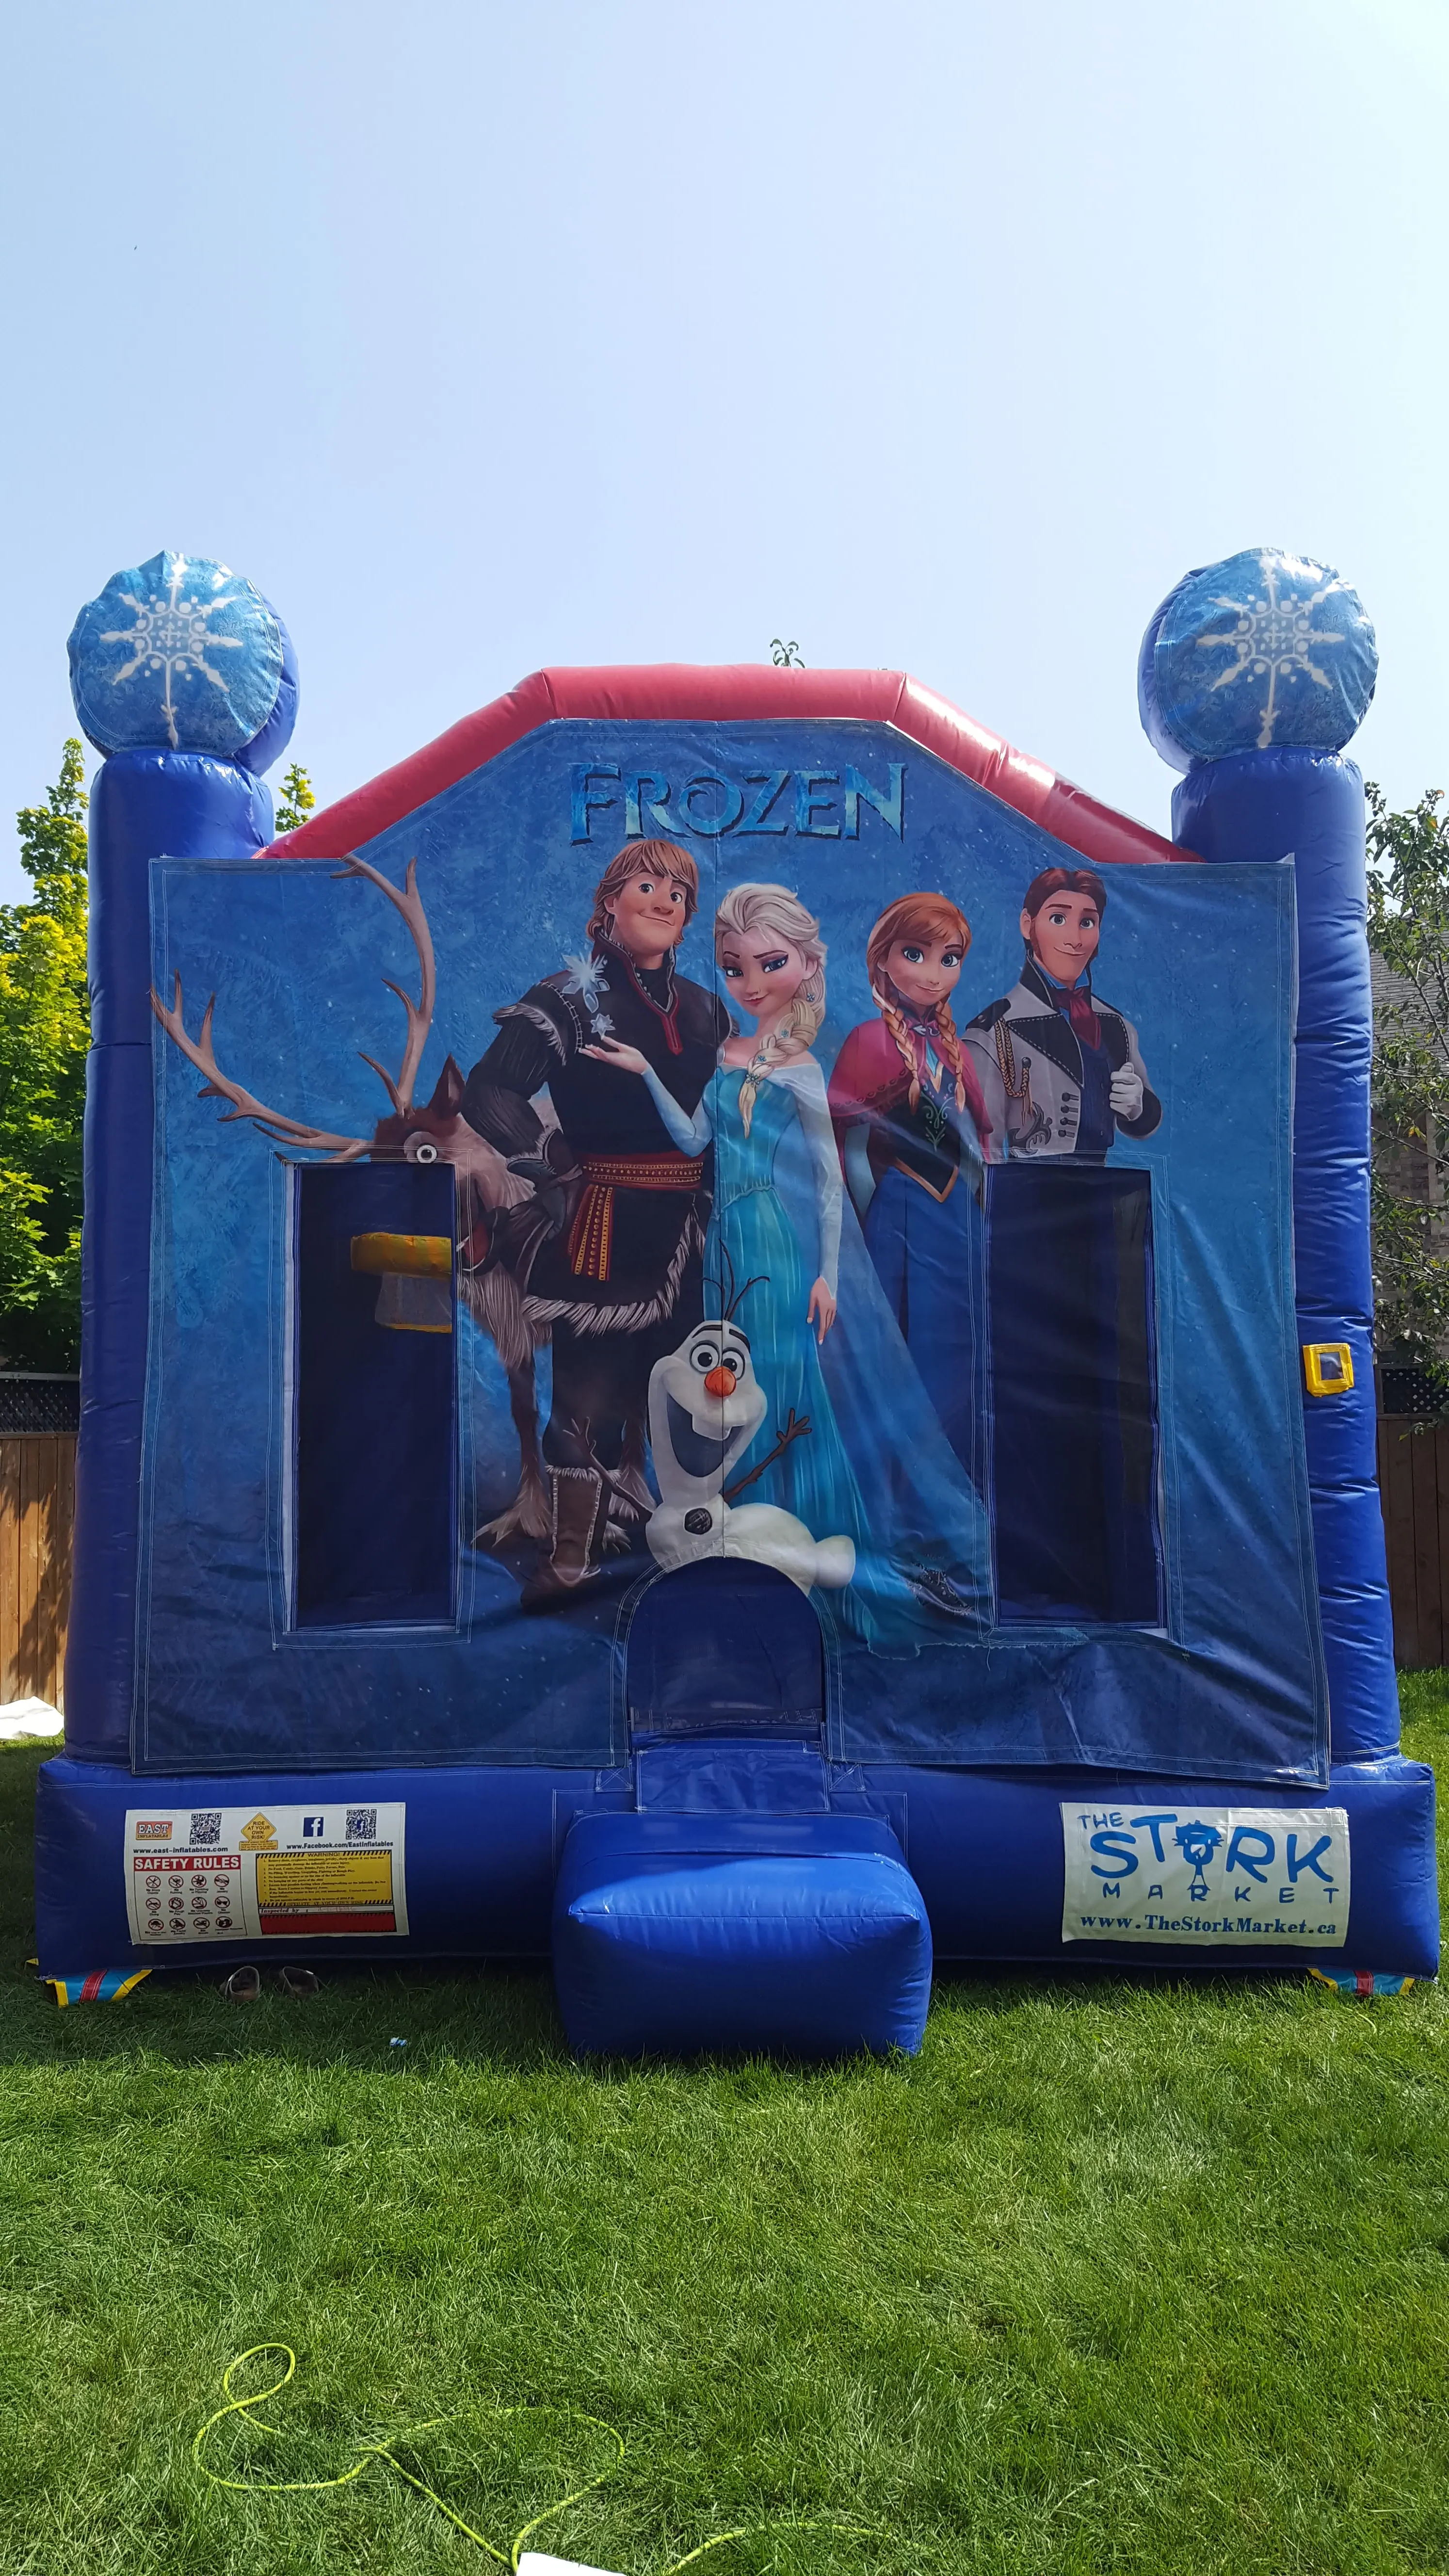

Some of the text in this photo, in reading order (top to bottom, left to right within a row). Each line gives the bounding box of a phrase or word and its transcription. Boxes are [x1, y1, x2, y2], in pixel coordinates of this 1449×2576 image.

[568, 762, 908, 846] FROZEN
[138, 1824, 169, 1834] EAST
[1077, 1812, 1124, 1830] THE
[1090, 1813, 1334, 1884] STORK
[135, 1856, 239, 1869] SAFETY RULES
[1103, 1882, 1340, 1904] MARKET
[1080, 1915, 1336, 1935] www.TheStorkMarket.ca
